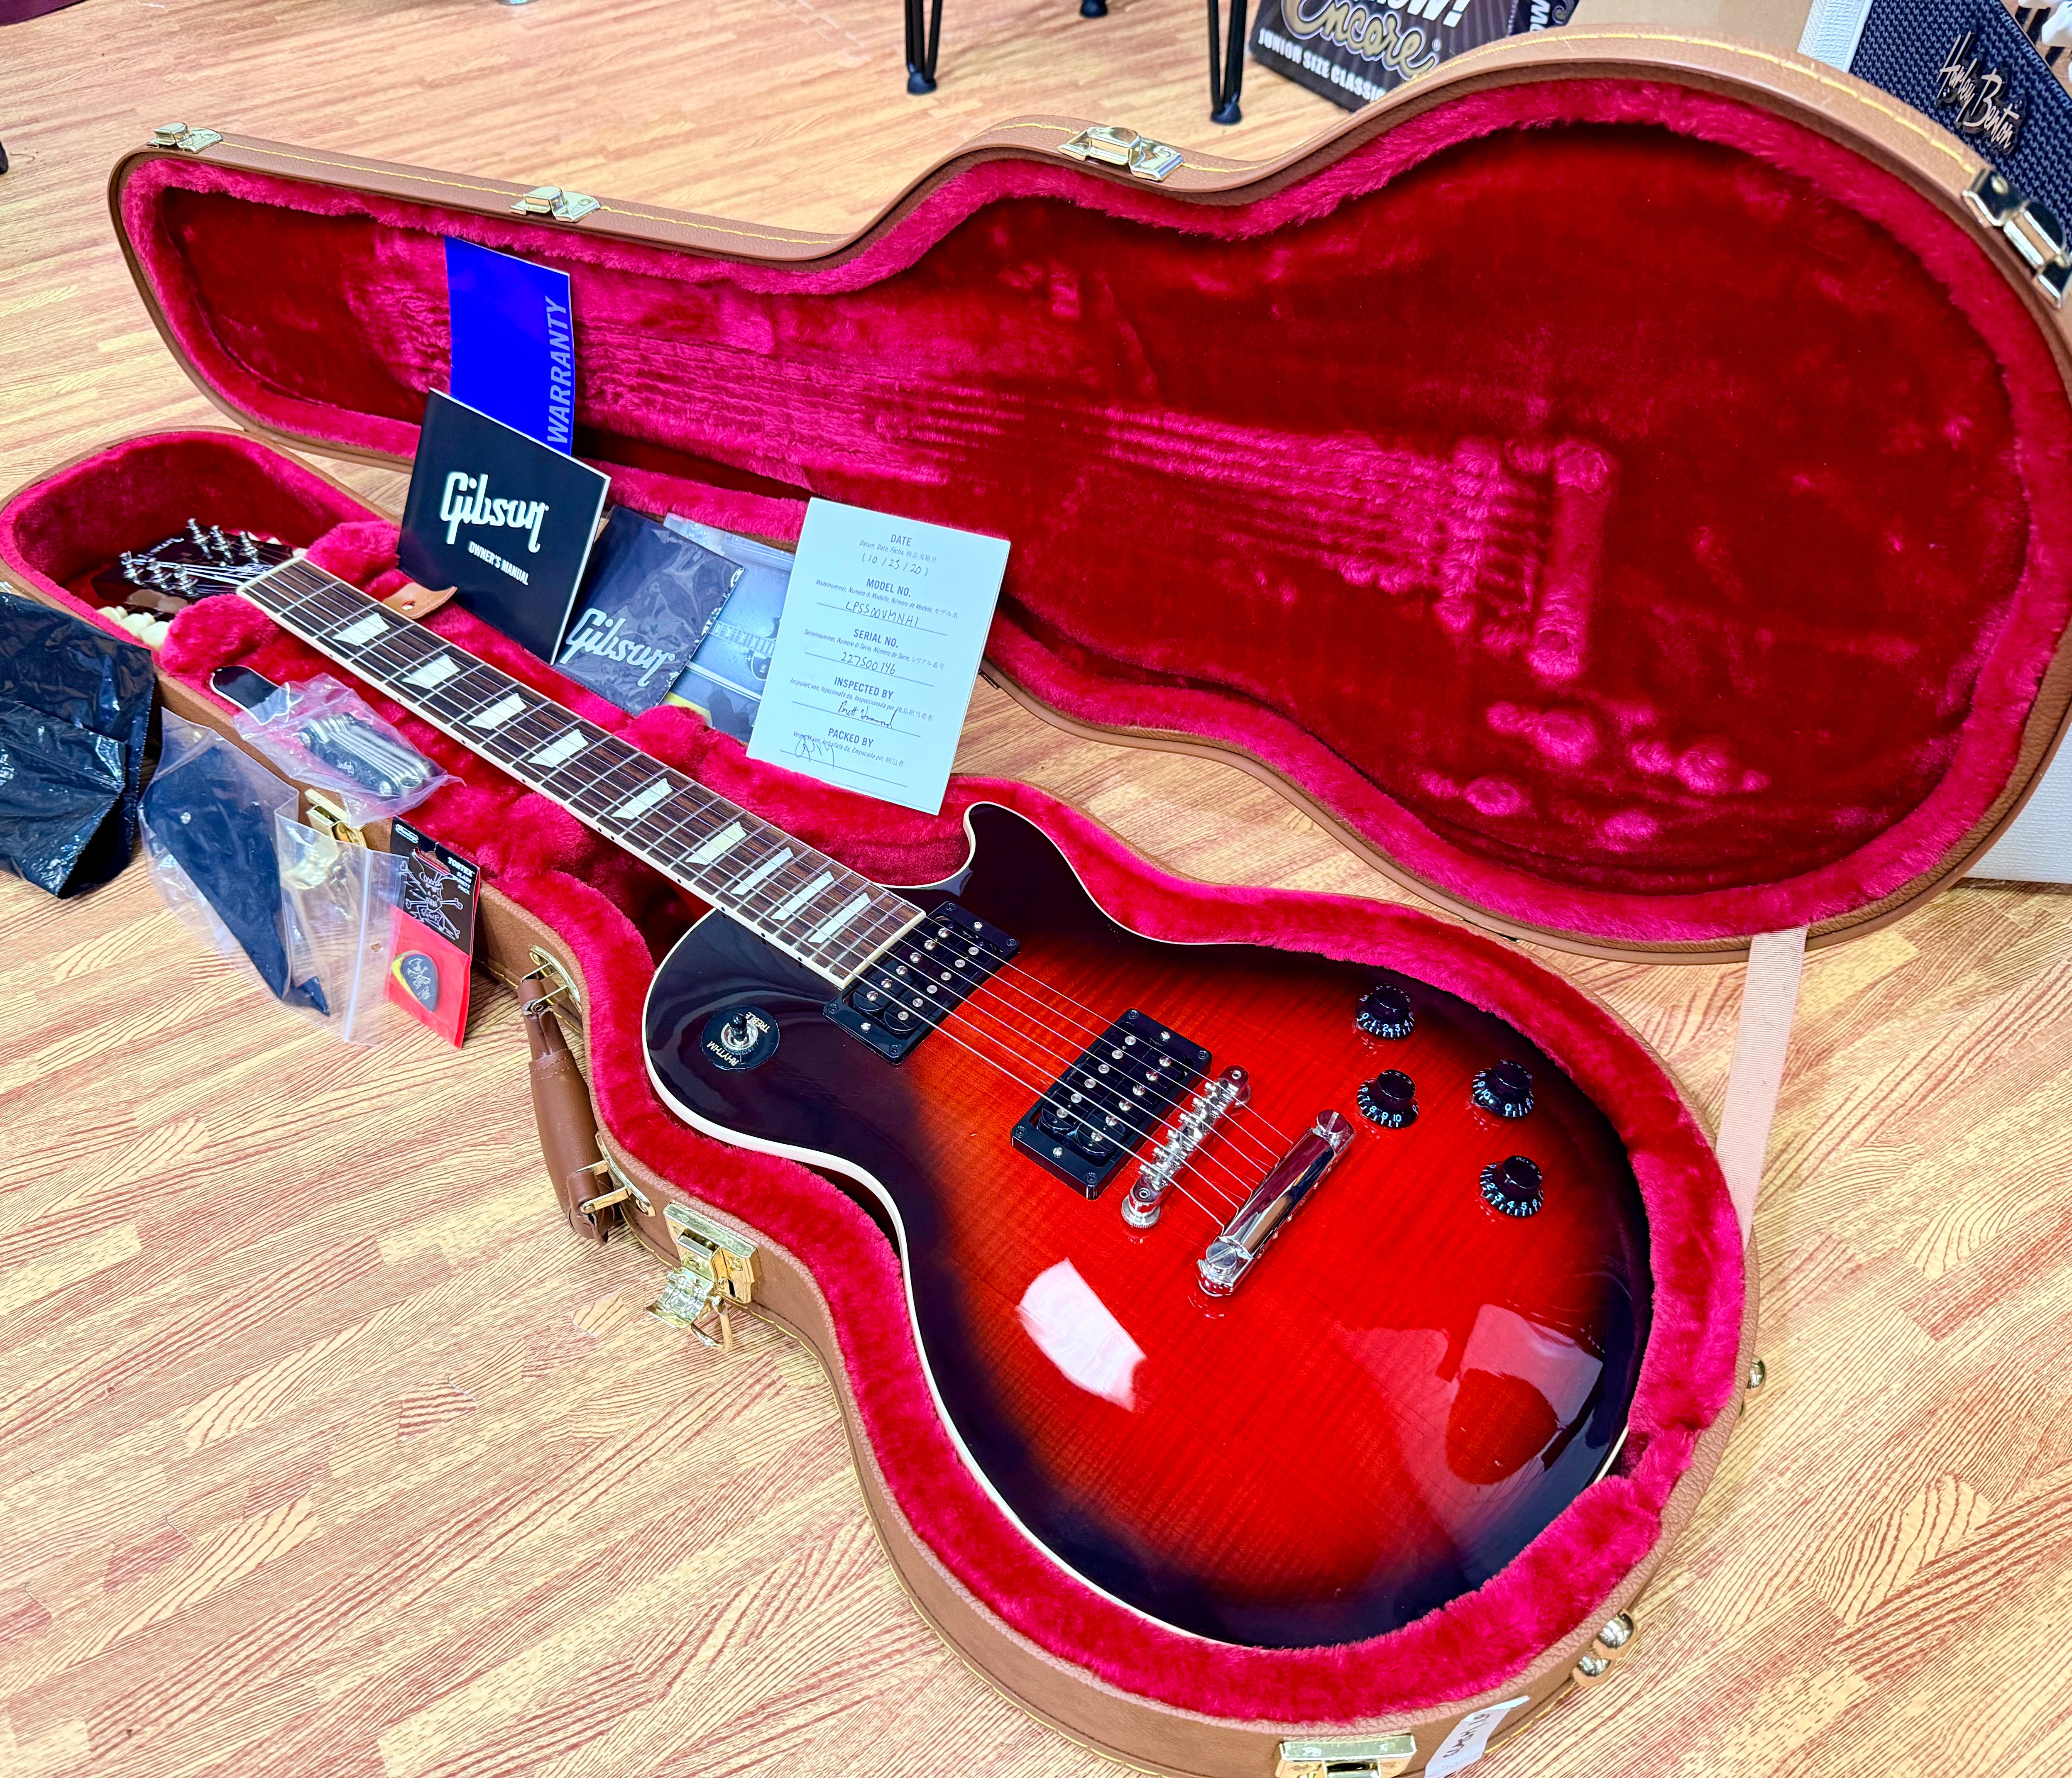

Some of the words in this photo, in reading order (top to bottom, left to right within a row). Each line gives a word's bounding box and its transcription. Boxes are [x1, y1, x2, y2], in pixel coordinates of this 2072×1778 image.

[1258, 27, 1302, 64] JUNIOR
[1303, 50, 1330, 78] SIZE
[1937, 31, 1977, 122] Harley
[1963, 68, 2020, 149] Benton
[545, 296, 571, 443] WARRANTY
[440, 471, 546, 553] Gibson
[890, 534, 912, 546] DATE
[468, 541, 501, 568] OWNER'S
[501, 559, 529, 585] MANUAL
[866, 578, 894, 593] MODEL
[897, 586, 911, 597] NO.
[560, 608, 670, 687] Gibson
[854, 629, 881, 643] SERIAL
[885, 638, 898, 648] NO.
[834, 677, 879, 696] INSPECTED
[882, 689, 894, 699] BY
[828, 728, 859, 744] PACKED
[862, 738, 873, 747] BY
[448, 857, 474, 877] TORTEX
[746, 1012, 770, 1033] TREBLE
[1383, 1024, 1389, 1032] 2
[707, 1041, 739, 1066] RHYTHM
[1481, 1089, 1491, 1099] 10
[1505, 1103, 1512, 1111] 0
[1521, 1202, 1527, 1211] 5
